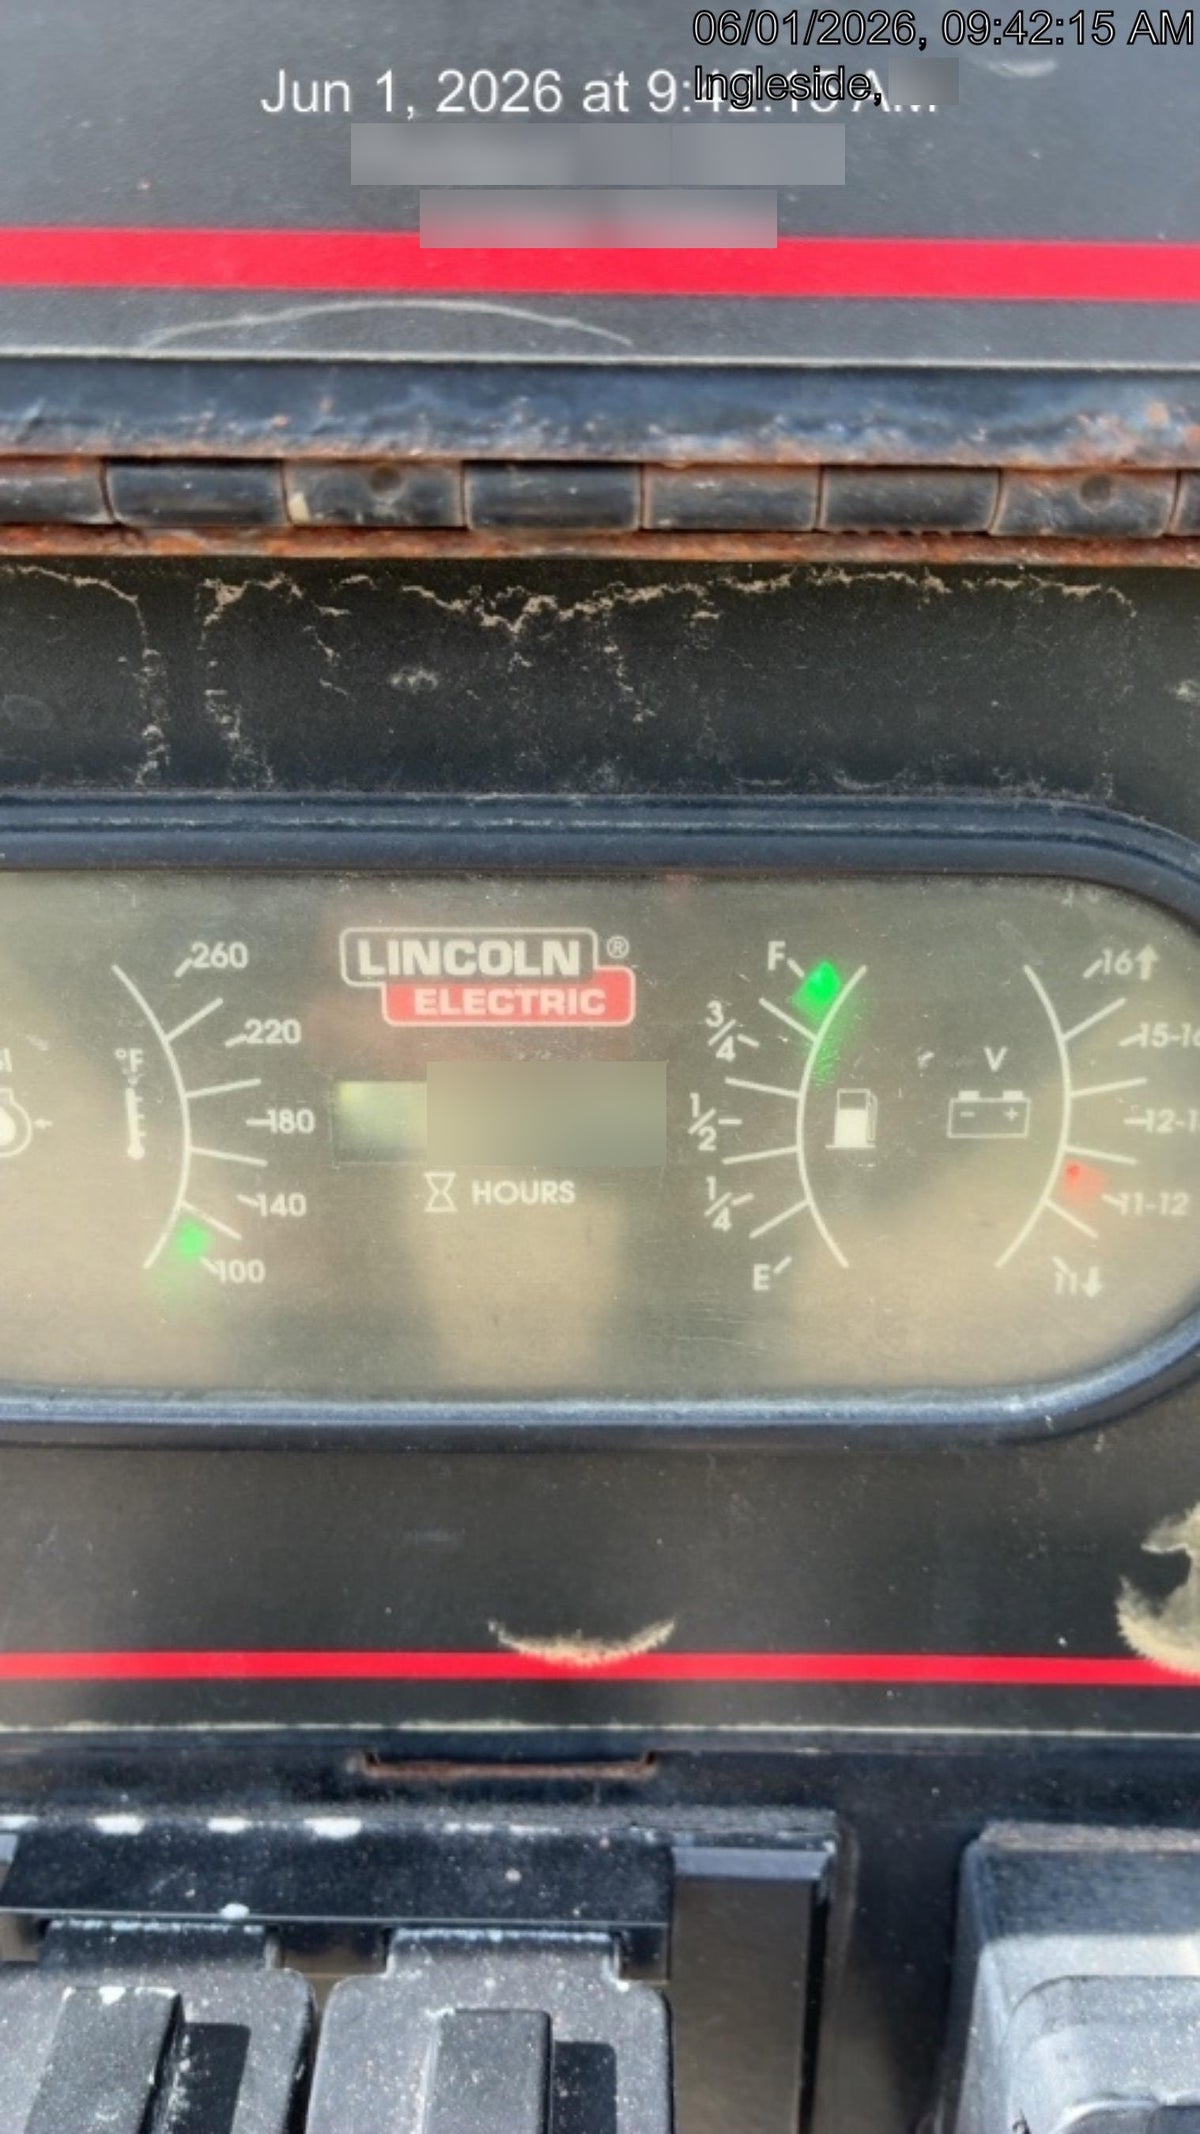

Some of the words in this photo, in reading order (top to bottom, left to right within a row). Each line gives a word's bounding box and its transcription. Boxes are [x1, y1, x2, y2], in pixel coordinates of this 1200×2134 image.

[190, 941, 249, 970] 260
[357, 938, 581, 977] LINCOLN
[767, 940, 787, 971] F
[1101, 948, 1134, 976] 16
[413, 987, 607, 1017] ELECTRIC
[243, 1018, 301, 1045] 220
[983, 1046, 1008, 1073] V
[266, 1108, 316, 1135] 180
[1145, 1108, 1200, 1134] 12-1
[255, 1192, 307, 1218] 140
[470, 1179, 576, 1205] HOURS
[1117, 1191, 1190, 1216] 11-12
[214, 1258, 266, 1284] 100
[752, 1263, 771, 1291] E
